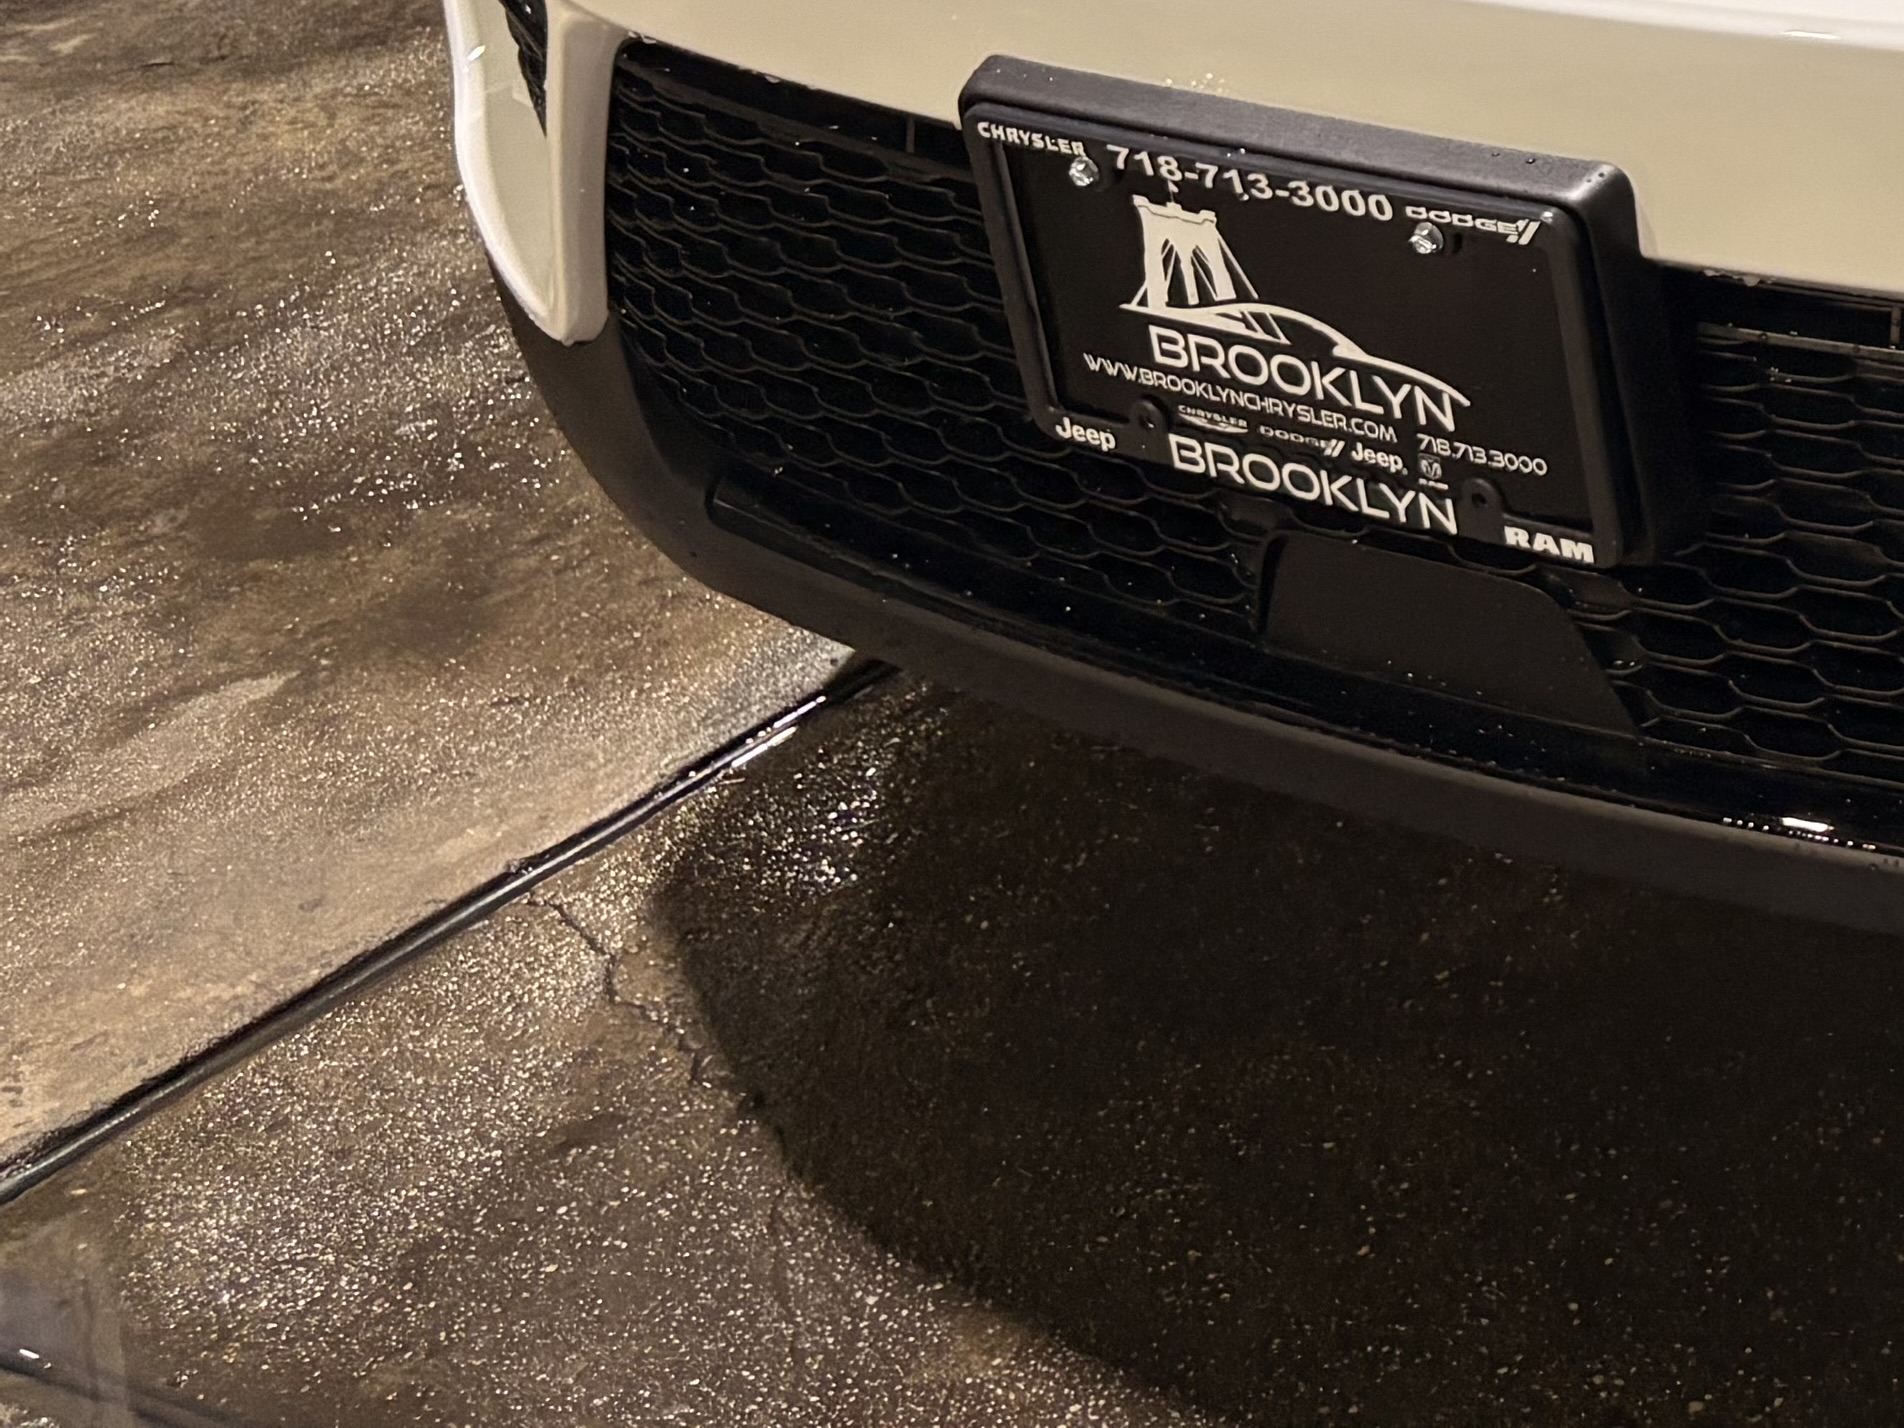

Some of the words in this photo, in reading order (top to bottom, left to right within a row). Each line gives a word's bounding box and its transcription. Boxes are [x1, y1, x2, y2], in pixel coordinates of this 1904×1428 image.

[977, 121, 1086, 157] CHRYSLER
[1106, 144, 1394, 221] 718-713-3000
[1405, 206, 1520, 234] DODGE
[1083, 352, 1398, 443] WWW.BROOKLYNCHRYSLER.COM
[1149, 324, 1456, 432] BROOKLYN
[1055, 417, 1116, 452] Jeep
[1177, 404, 1249, 428] CHRYSLER
[1351, 442, 1403, 473] Jeep
[1416, 433, 1548, 476] 718.713.3000
[1168, 433, 1458, 536] BROOKLYN
[1503, 525, 1595, 564] RAM
